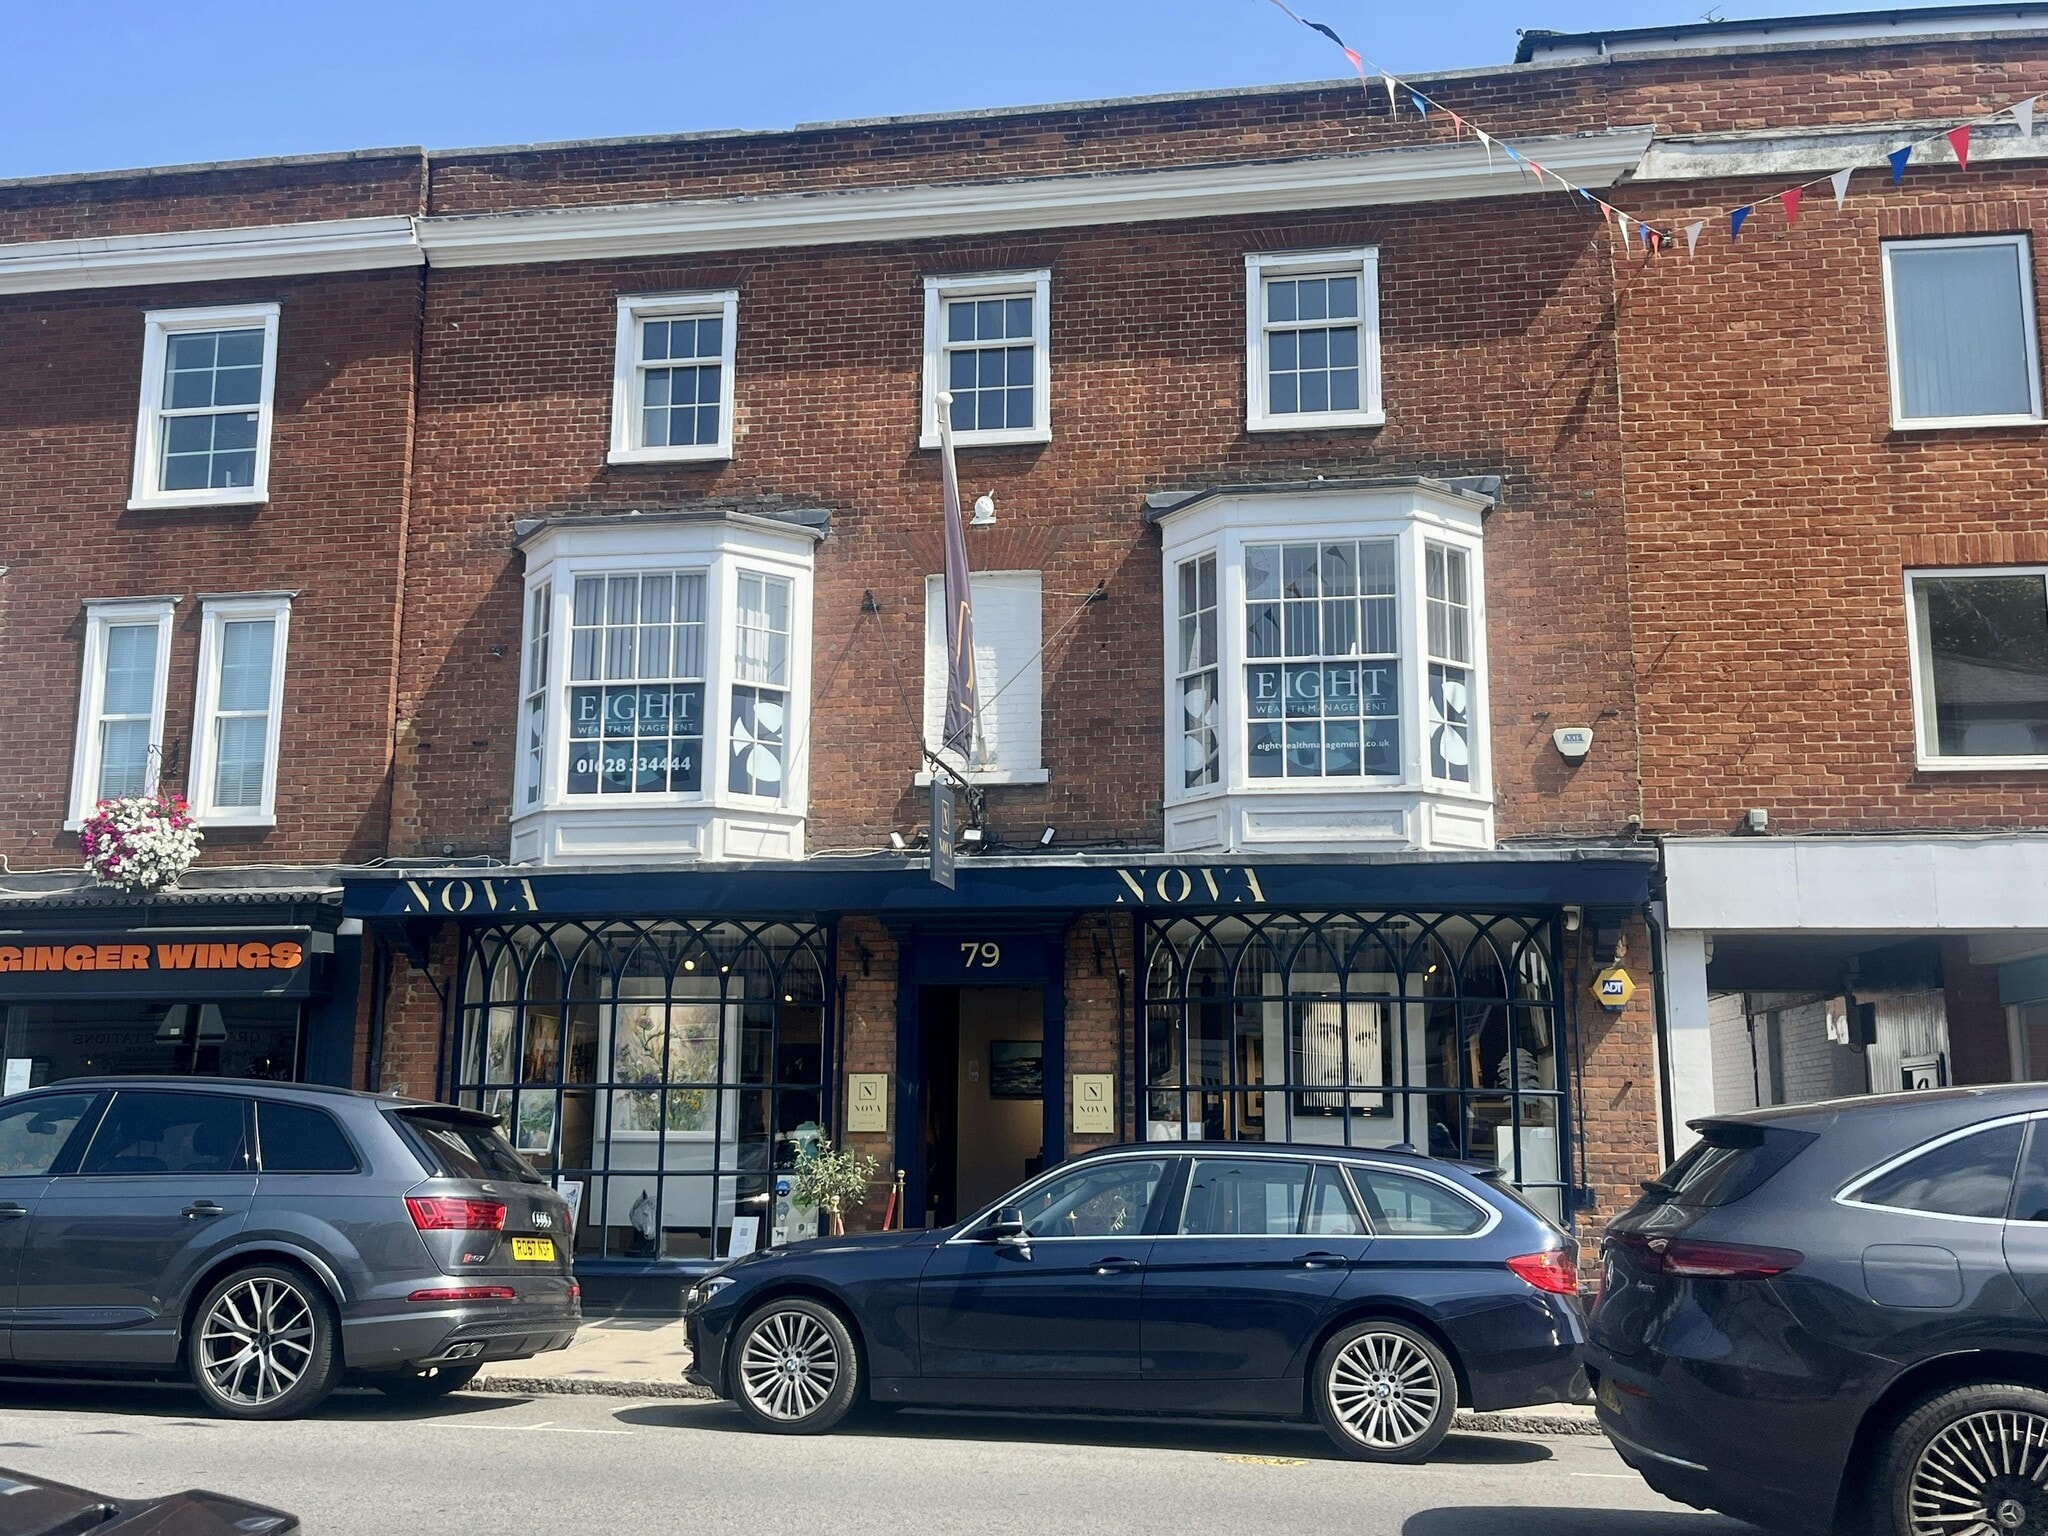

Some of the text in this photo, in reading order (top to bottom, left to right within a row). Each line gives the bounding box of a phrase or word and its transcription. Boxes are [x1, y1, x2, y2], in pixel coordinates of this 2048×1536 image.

[1255, 668, 1387, 699] EIGHT
[578, 692, 696, 721] EIGHT
[1255, 702, 1387, 714] WEATH MNAGEENT
[577, 723, 694, 734] WEATH MNAGEENT
[1257, 739, 1390, 752] eightealthmaagemen.co.uk
[577, 758, 627, 773] 01628
[1115, 868, 1267, 903] NOVA
[403, 879, 539, 912] NOVA
[0, 942, 303, 972] GINGER WINGS
[961, 942, 1000, 968] 79
[1603, 981, 1623, 993] ADT
[854, 1104, 881, 1112] NOVA
[1079, 1105, 1108, 1113] NOVA
